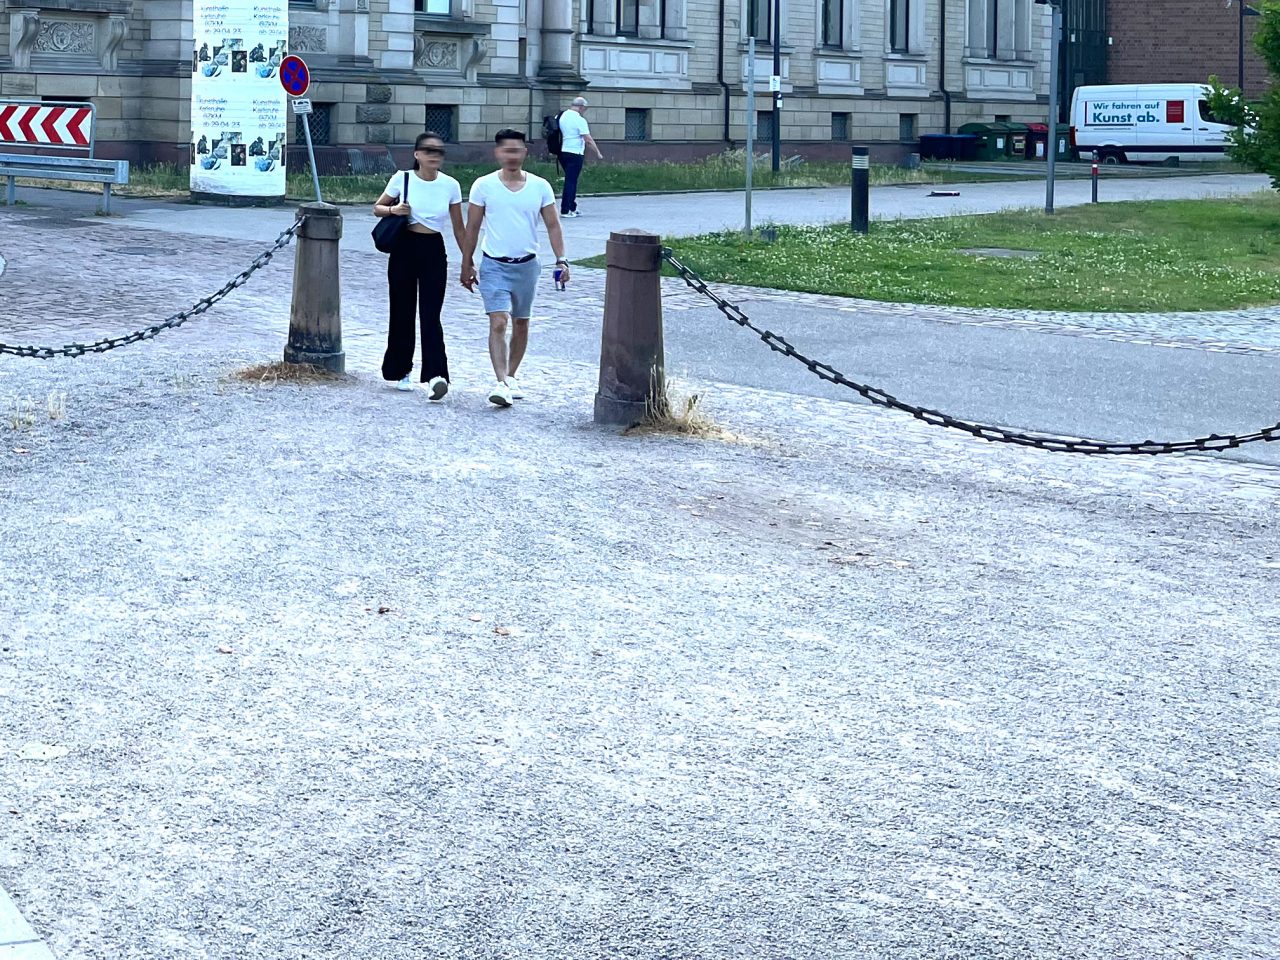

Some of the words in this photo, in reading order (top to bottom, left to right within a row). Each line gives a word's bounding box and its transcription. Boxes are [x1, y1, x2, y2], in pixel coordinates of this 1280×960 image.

[1093, 102, 1109, 110] Wir
[1112, 102, 1141, 110] fahren
[1144, 101, 1160, 110] auf
[1092, 112, 1133, 123] Kunst
[1136, 111, 1160, 123] ab.
